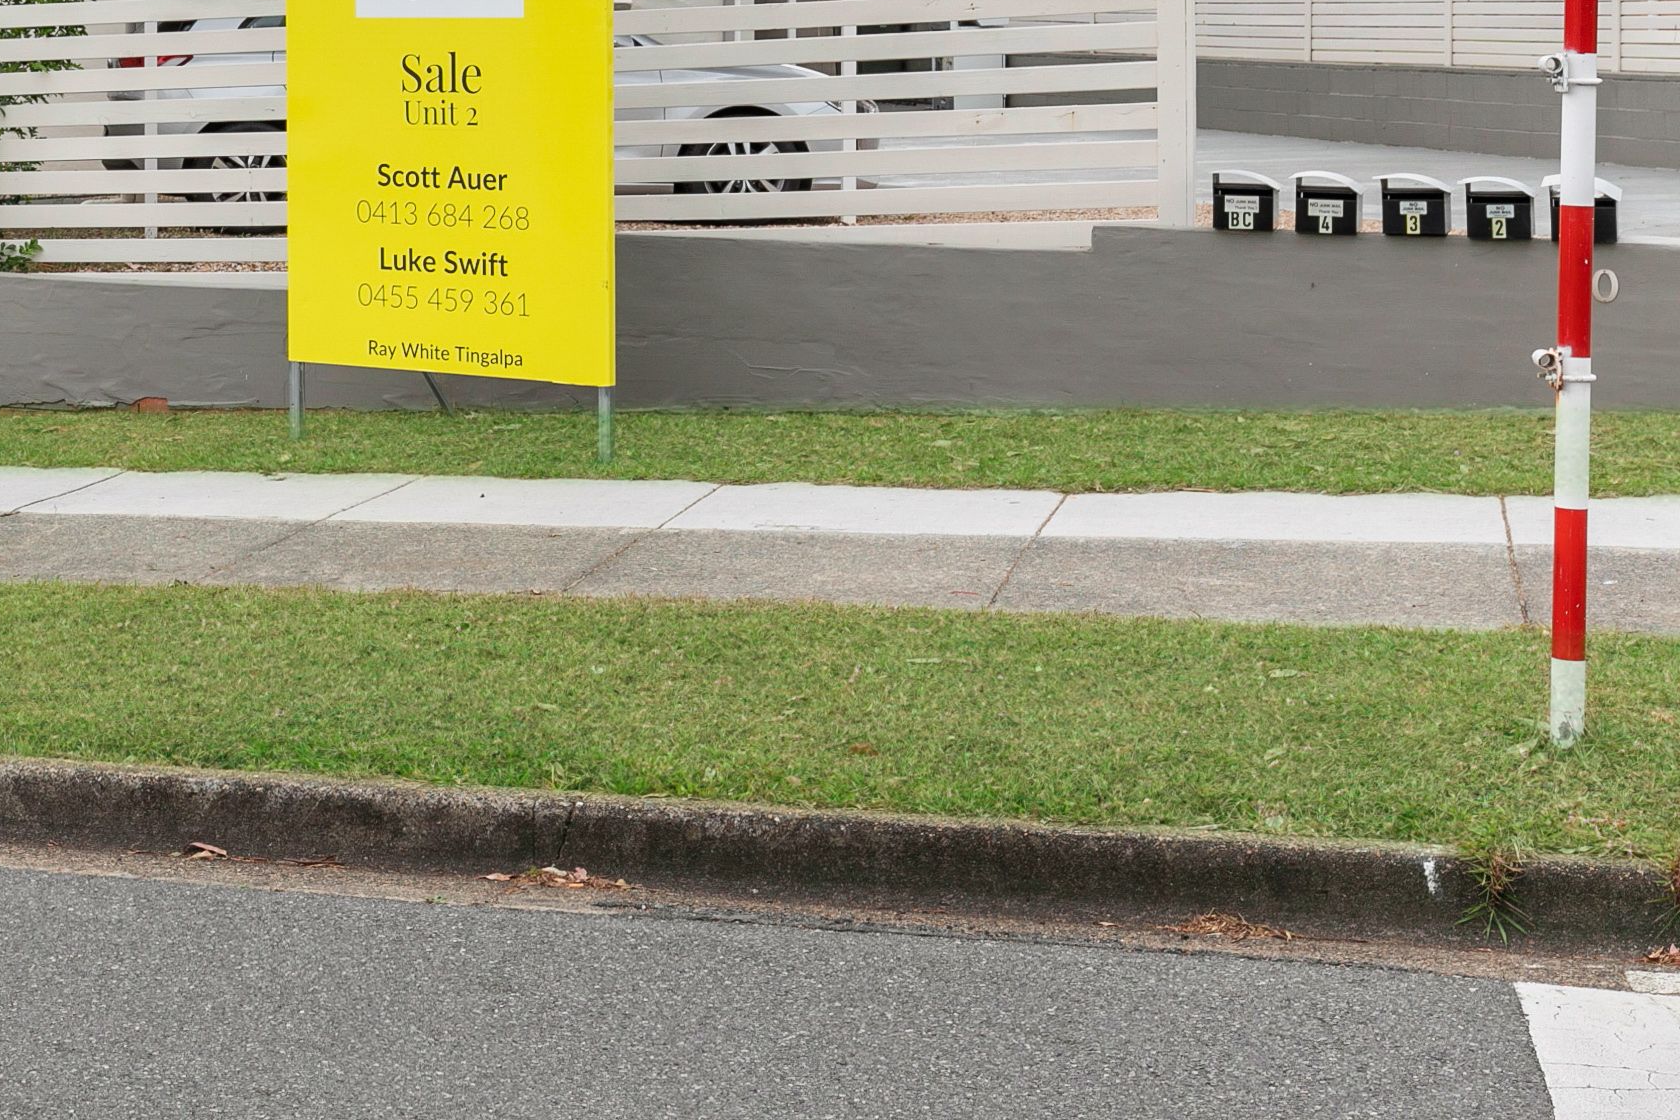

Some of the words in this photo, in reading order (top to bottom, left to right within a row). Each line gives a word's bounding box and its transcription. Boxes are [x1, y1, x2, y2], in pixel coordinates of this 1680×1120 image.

[401, 51, 482, 94] Sale
[404, 99, 459, 127] Unit
[466, 106, 479, 126] 2
[377, 163, 441, 189] Scott
[447, 166, 508, 192] Auer
[356, 199, 418, 226] 0413
[427, 203, 474, 227] 684
[482, 205, 530, 231] 268
[1321, 216, 1330, 231] 4
[1409, 216, 1418, 231] 3
[1494, 220, 1504, 236] 2
[380, 246, 437, 273] Luke
[443, 250, 509, 277] Swift
[357, 283, 419, 310] 0455
[428, 287, 474, 313] 459
[483, 290, 530, 317] 361
[368, 339, 397, 360] Ray
[401, 342, 450, 361] White
[454, 346, 524, 368] Tingalpa
